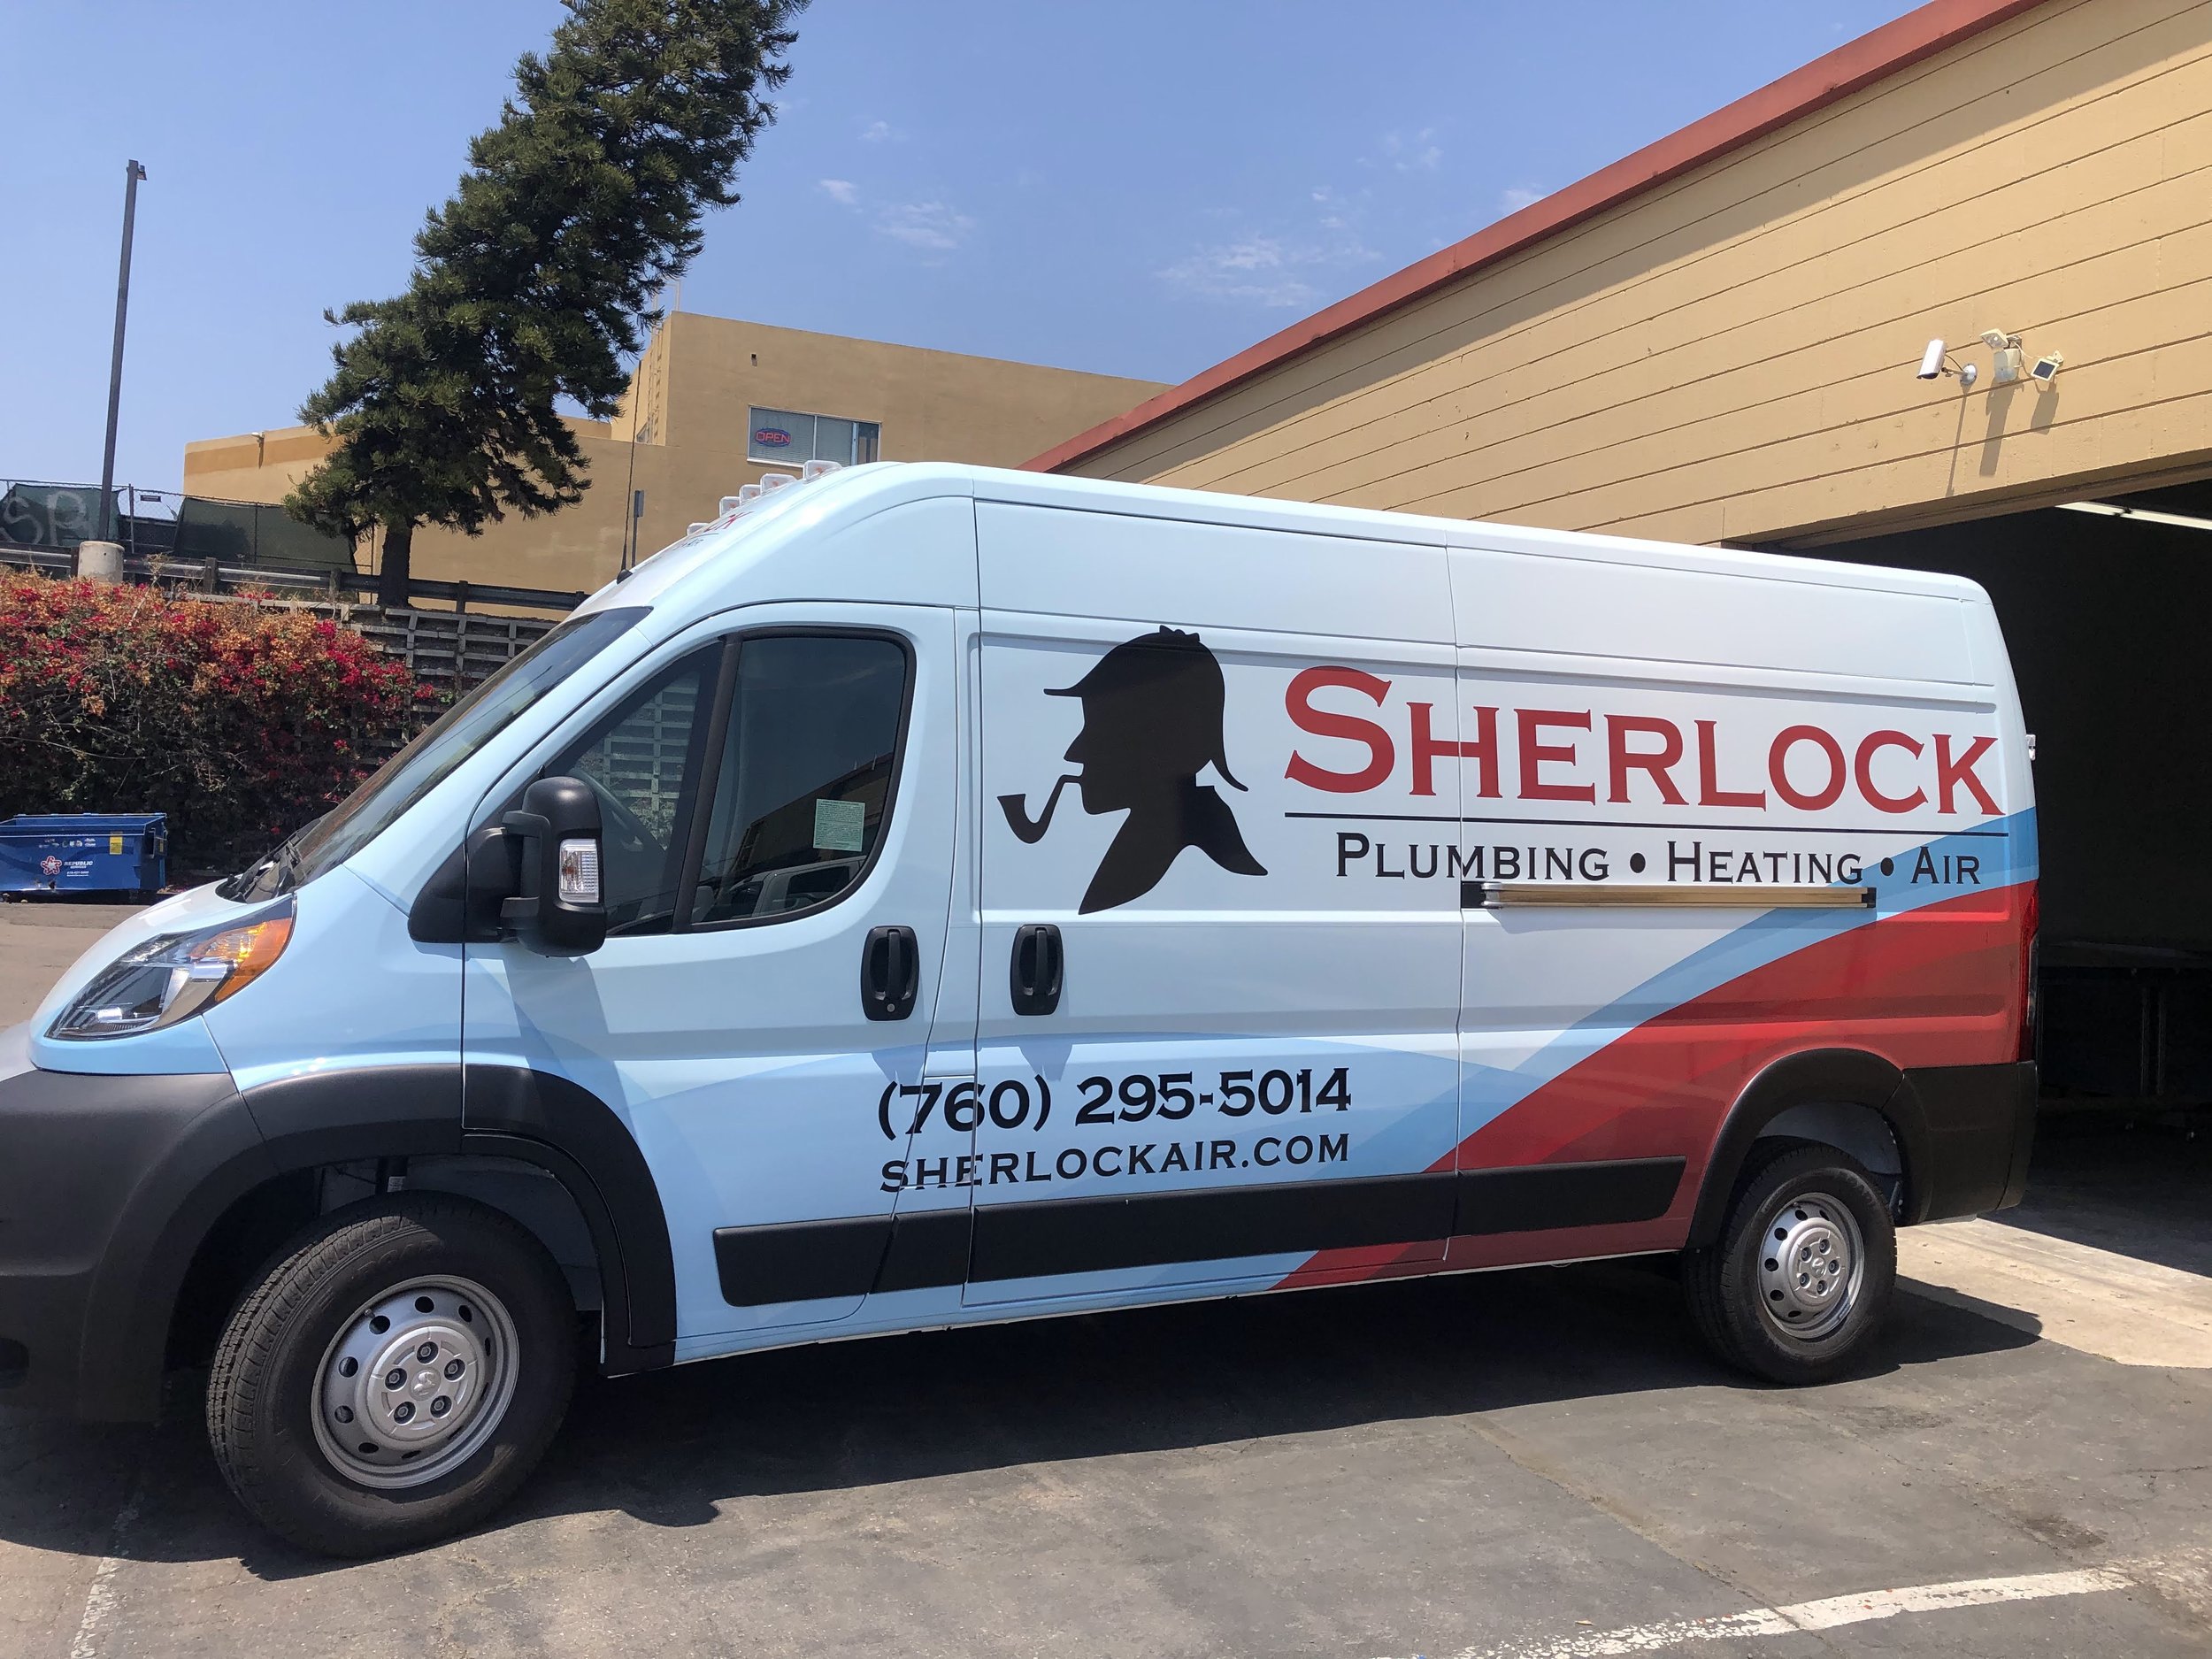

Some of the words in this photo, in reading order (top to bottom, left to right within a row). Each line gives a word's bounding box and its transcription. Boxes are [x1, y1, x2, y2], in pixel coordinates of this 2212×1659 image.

[756, 431, 790, 443] OPEN
[1284, 665, 2004, 816] SHERLOCK
[1337, 833, 1610, 881] PLUMBING
[1667, 841, 1863, 884] HEATING
[1912, 846, 1981, 885] AIR
[878, 1074, 1052, 1141] (760)
[1075, 1067, 1352, 1126] 295-5014
[880, 1133, 1349, 1193] SHERLOCKAIR.COM
